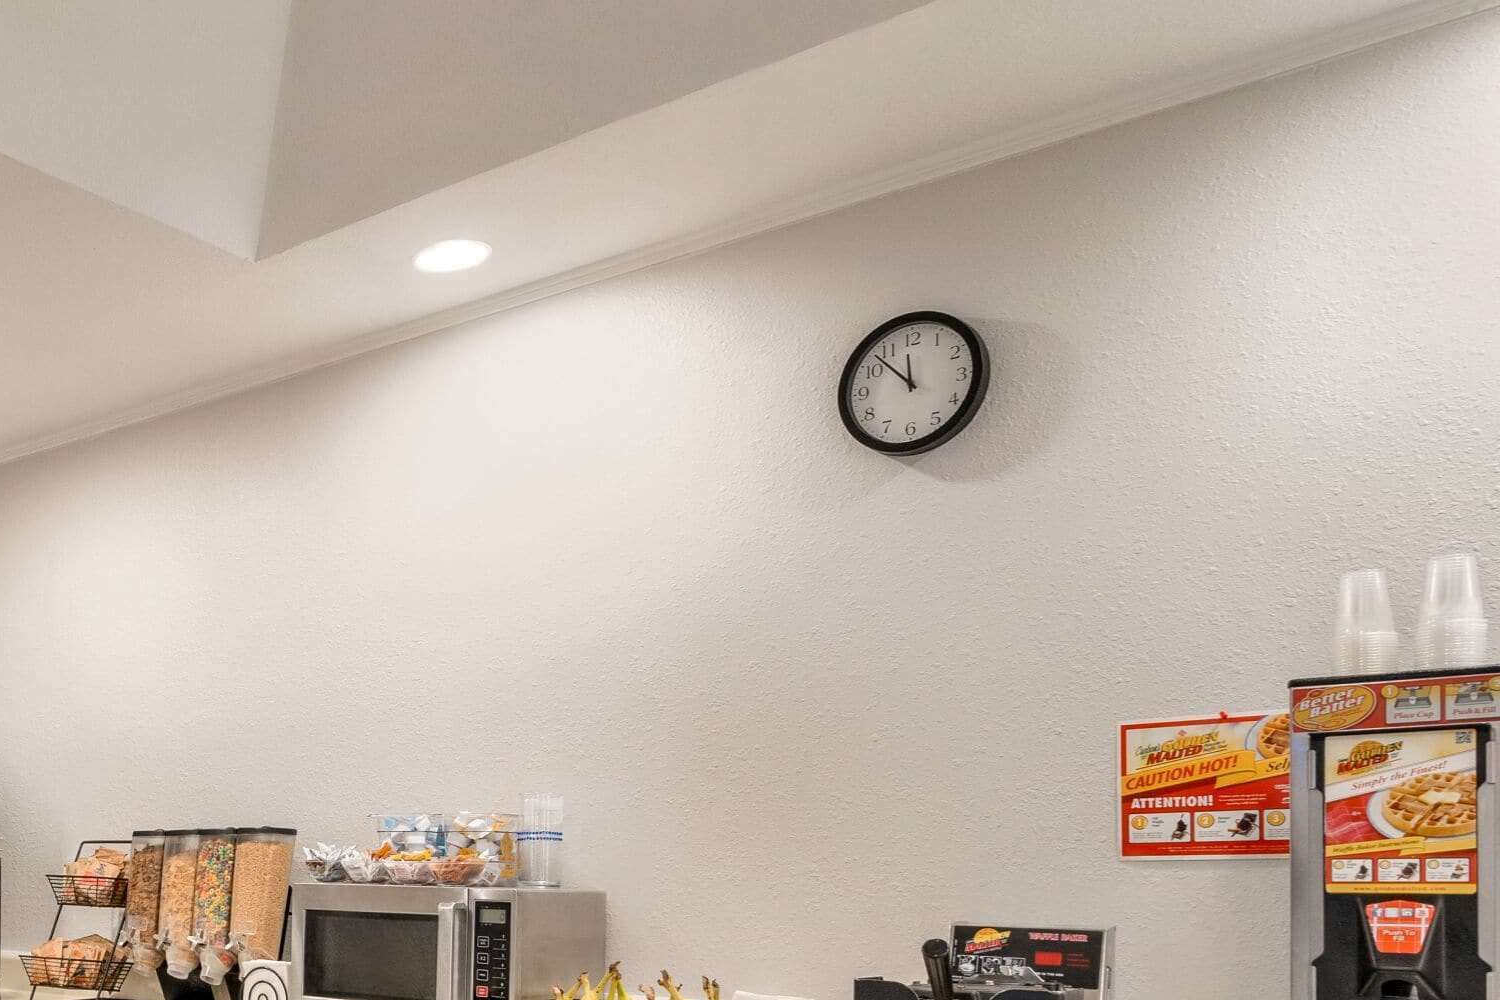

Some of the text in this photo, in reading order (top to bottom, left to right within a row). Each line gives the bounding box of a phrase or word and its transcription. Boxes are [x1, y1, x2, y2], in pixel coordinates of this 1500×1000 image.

[905, 331, 921, 347] 12
[934, 333, 940, 347] 1
[881, 343, 895, 358] 11
[949, 345, 961, 360] 2
[866, 363, 884, 379] 10
[955, 366, 967, 381] 3
[858, 386, 869, 401] 9
[948, 392, 960, 405] 4
[864, 407, 875, 421] 8
[930, 411, 941, 426] 5
[882, 419, 893, 434] 7
[905, 421, 916, 436] 6
[1146, 744, 1204, 766] MALTED
[1337, 754, 1389, 775] MALTED
[1125, 755, 1238, 791] CAUTION HOT!
[1350, 761, 1447, 791] Simply the Finest!
[1130, 794, 1214, 809] ATTENTION!
[1028, 932, 1059, 941] WAFFLE
[1061, 933, 1088, 942] BAKER
